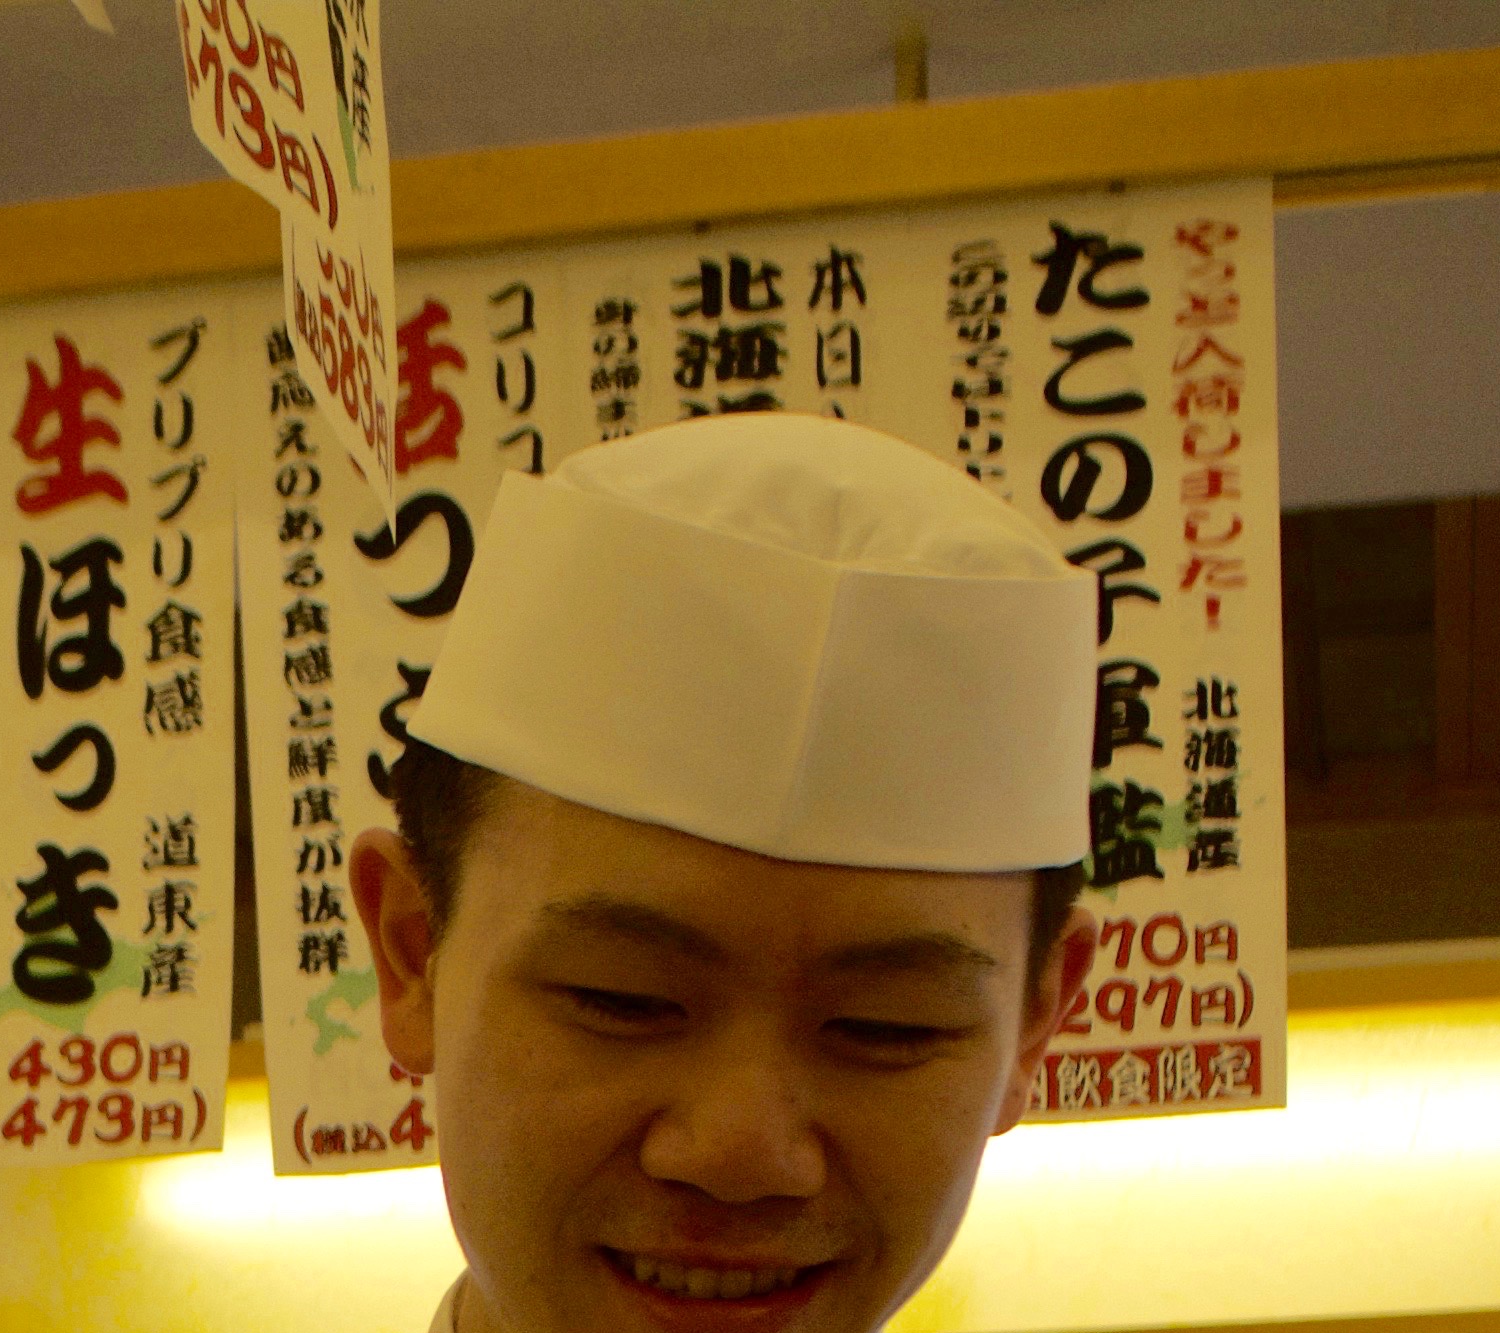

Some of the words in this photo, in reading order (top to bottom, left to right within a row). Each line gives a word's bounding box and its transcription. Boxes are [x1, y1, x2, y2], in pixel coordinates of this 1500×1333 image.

[808, 241, 867, 420] 本日
[1171, 217, 1247, 631] やっと入荷しました!
[11, 332, 130, 1005] 生ほっき
[1180, 675, 1245, 873] 北海道産
[140, 814, 200, 998] 道東産
[8, 1032, 192, 1090] 430円
